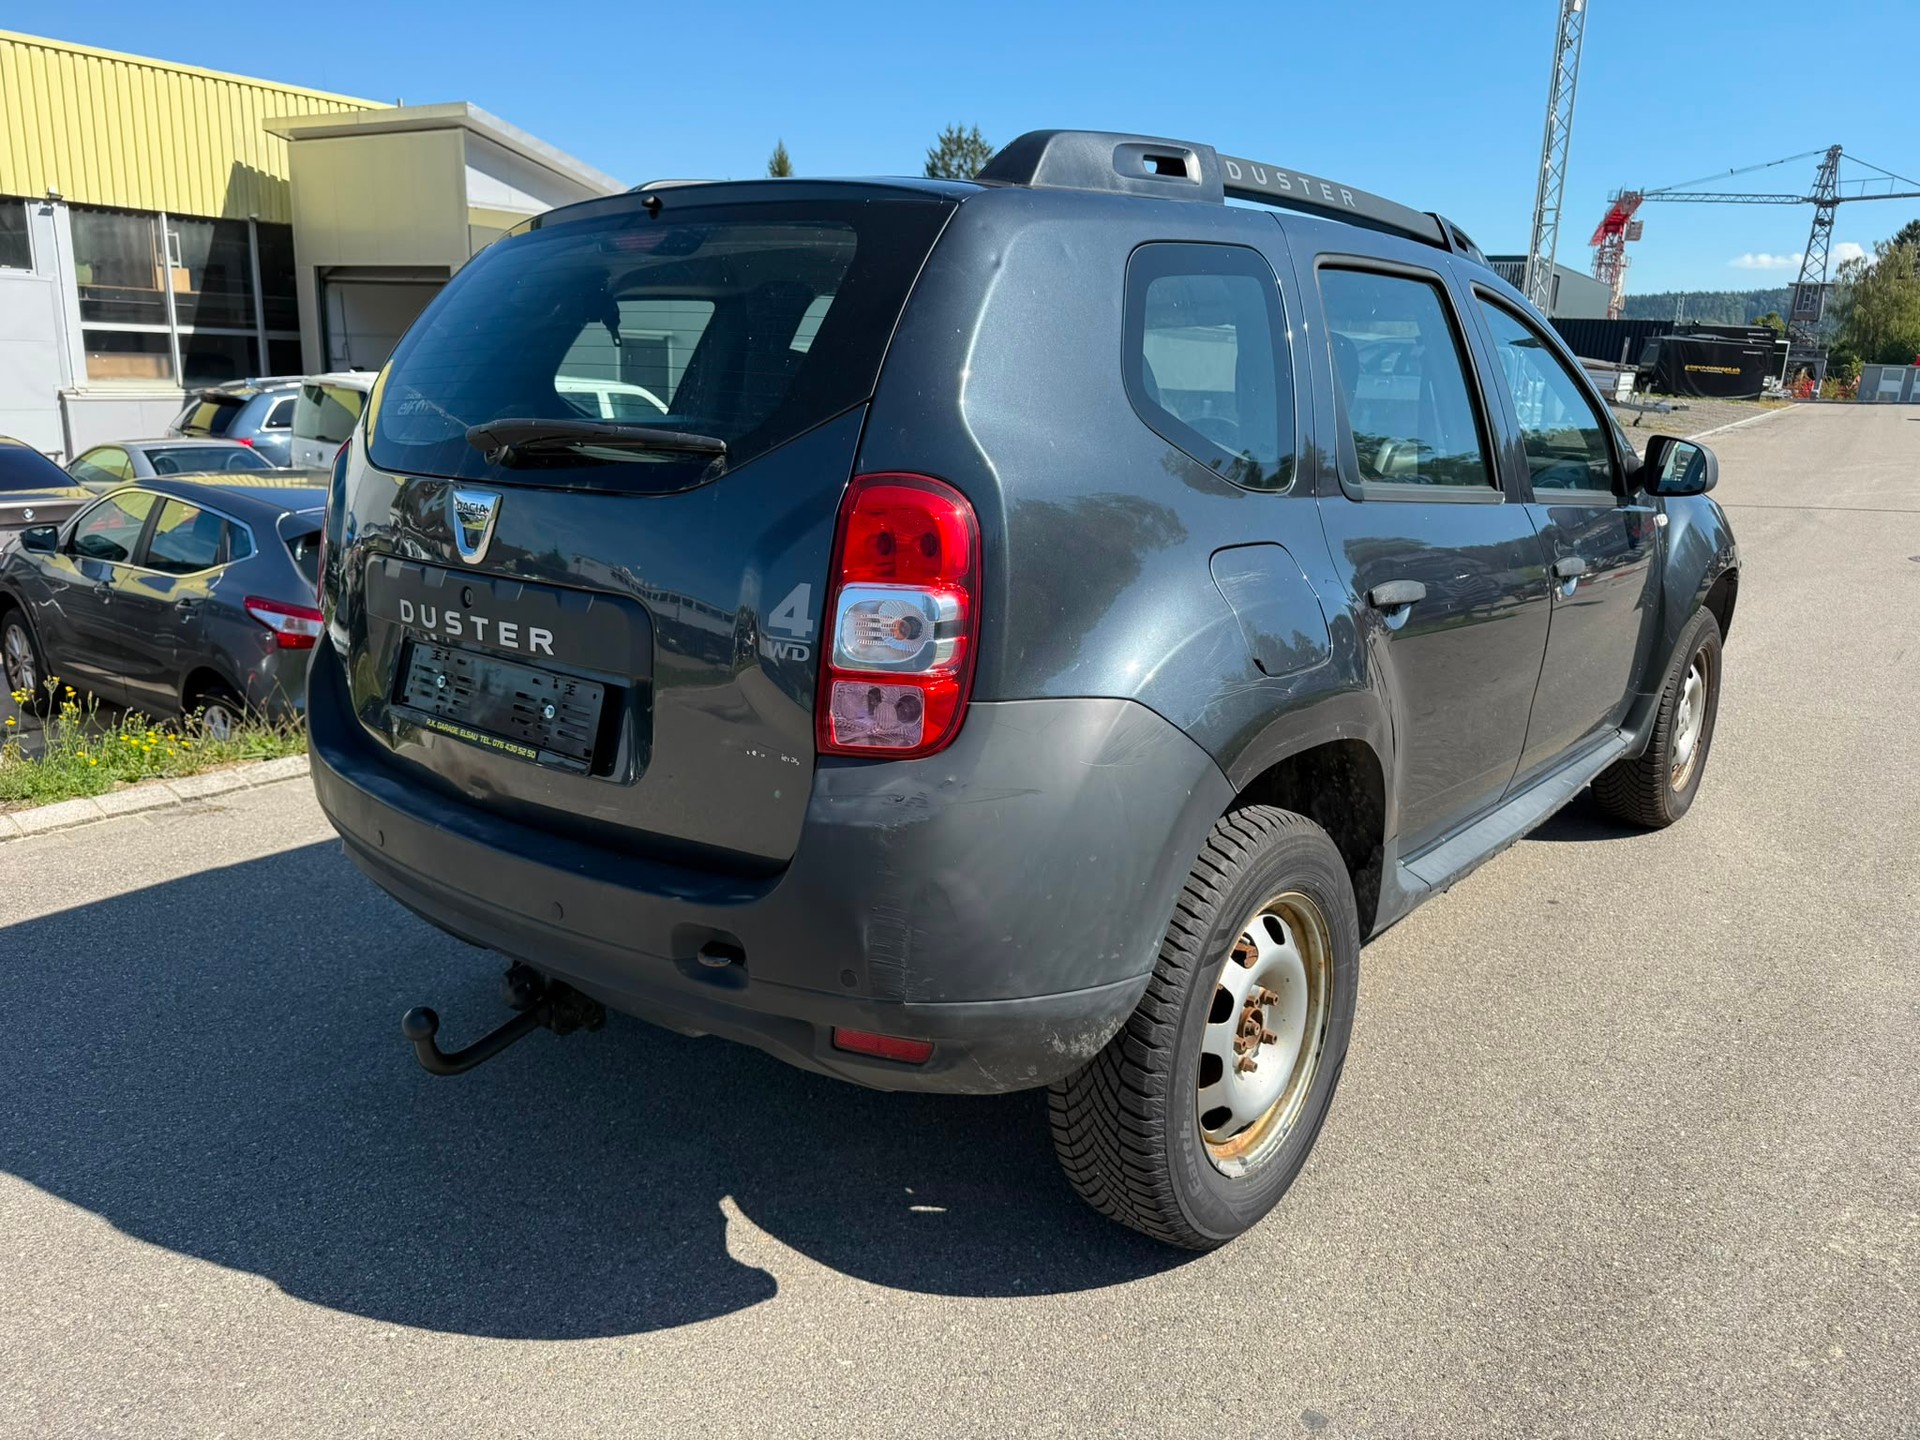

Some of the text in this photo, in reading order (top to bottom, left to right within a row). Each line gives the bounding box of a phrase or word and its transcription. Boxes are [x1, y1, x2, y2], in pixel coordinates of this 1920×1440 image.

[1225, 160, 1356, 208] DUSTER
[456, 501, 486, 514] DACIA
[400, 598, 555, 656] DUSTER
[768, 582, 814, 637] 4
[766, 640, 811, 663] WD
[437, 721, 460, 735] GARAGE
[460, 728, 479, 742] ELSAU
[505, 743, 518, 753] 430
[518, 747, 527, 756] 52
[527, 750, 537, 760] 50
